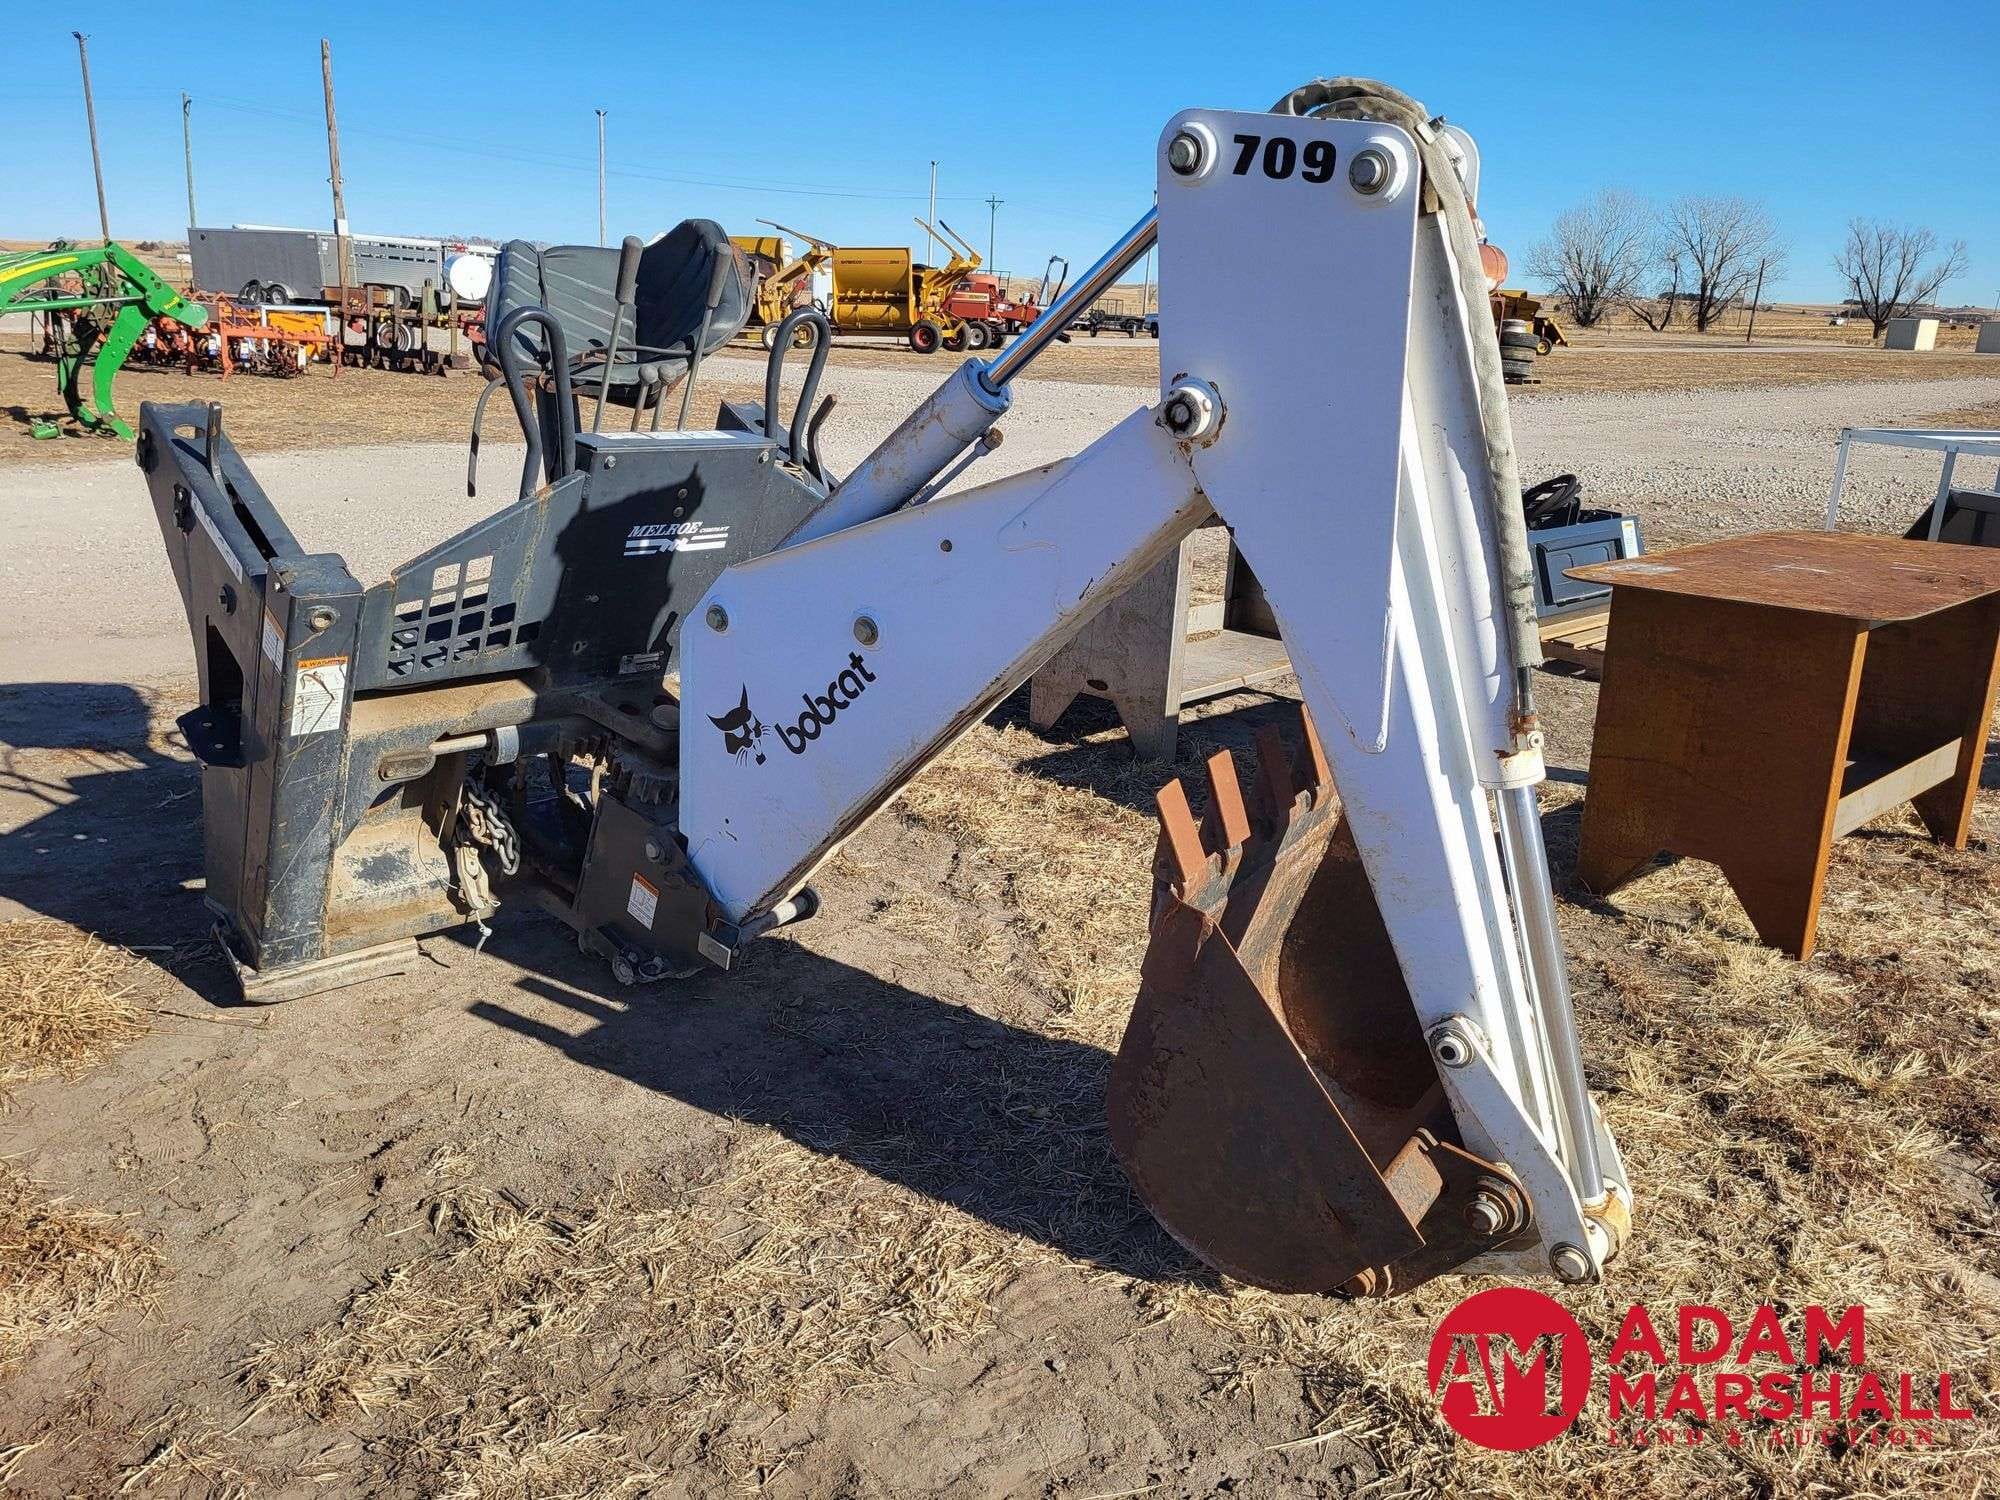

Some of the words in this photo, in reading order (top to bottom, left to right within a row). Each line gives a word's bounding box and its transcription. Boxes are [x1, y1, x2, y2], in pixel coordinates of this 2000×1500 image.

[1232, 134, 1337, 184] 709
[628, 521, 703, 538] MELROE
[774, 651, 877, 755] bobcat
